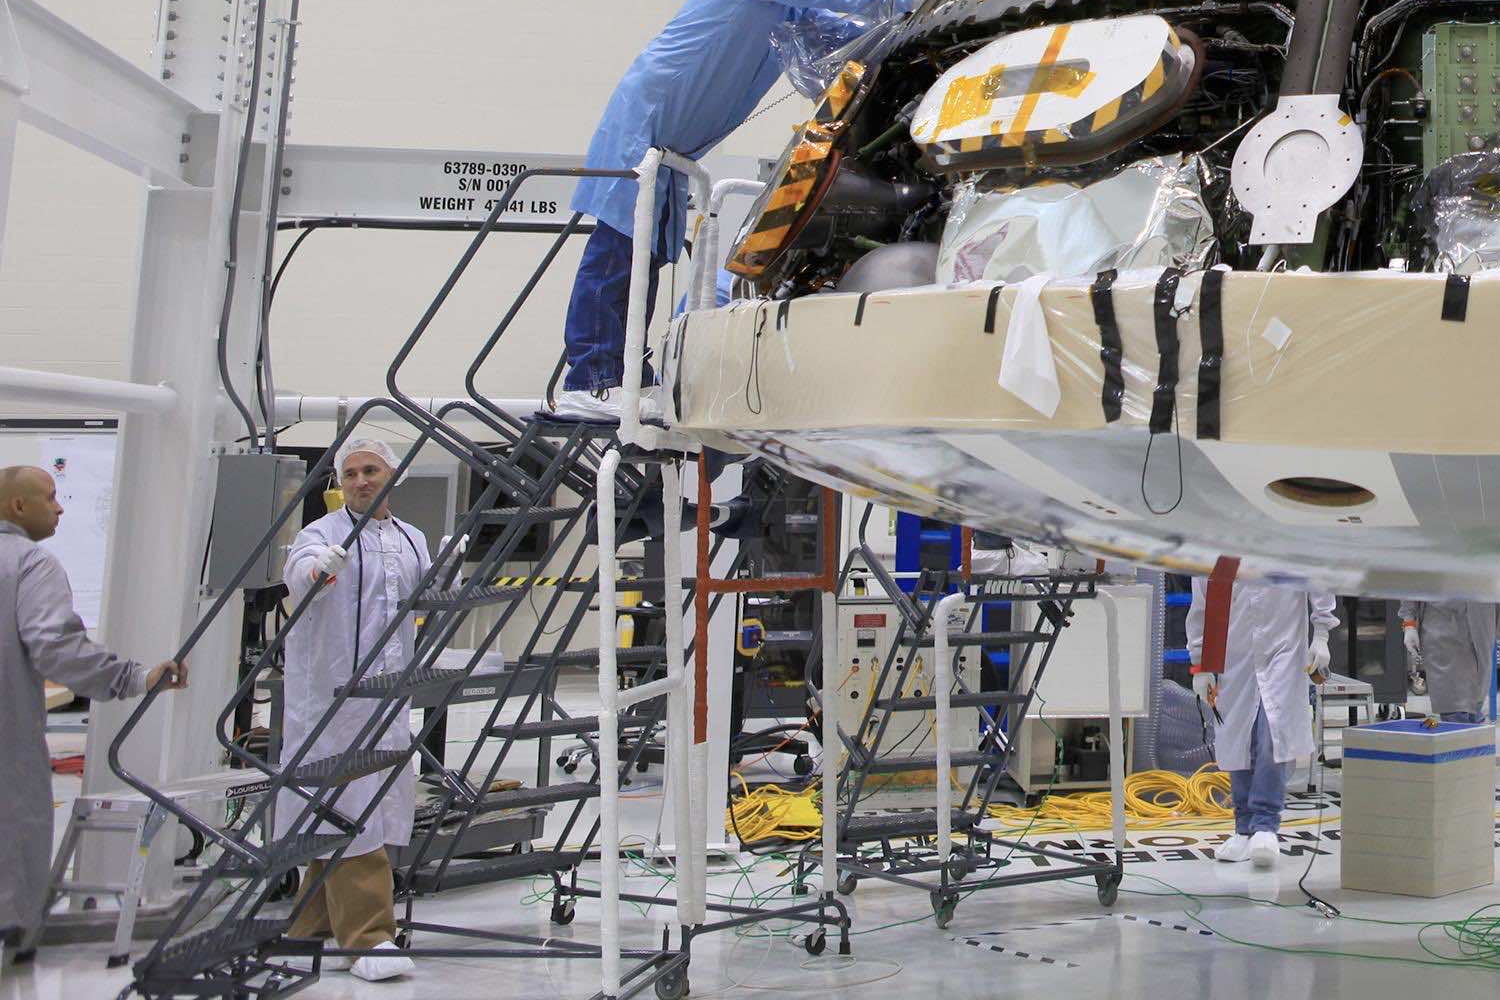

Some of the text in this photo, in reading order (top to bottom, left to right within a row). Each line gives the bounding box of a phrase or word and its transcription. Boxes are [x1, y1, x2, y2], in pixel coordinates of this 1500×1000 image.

[458, 178, 511, 192] S/N 001
[420, 196, 475, 211] WEIGHT
[531, 200, 557, 214] LBS
[233, 783, 271, 795] LOUISVILL
